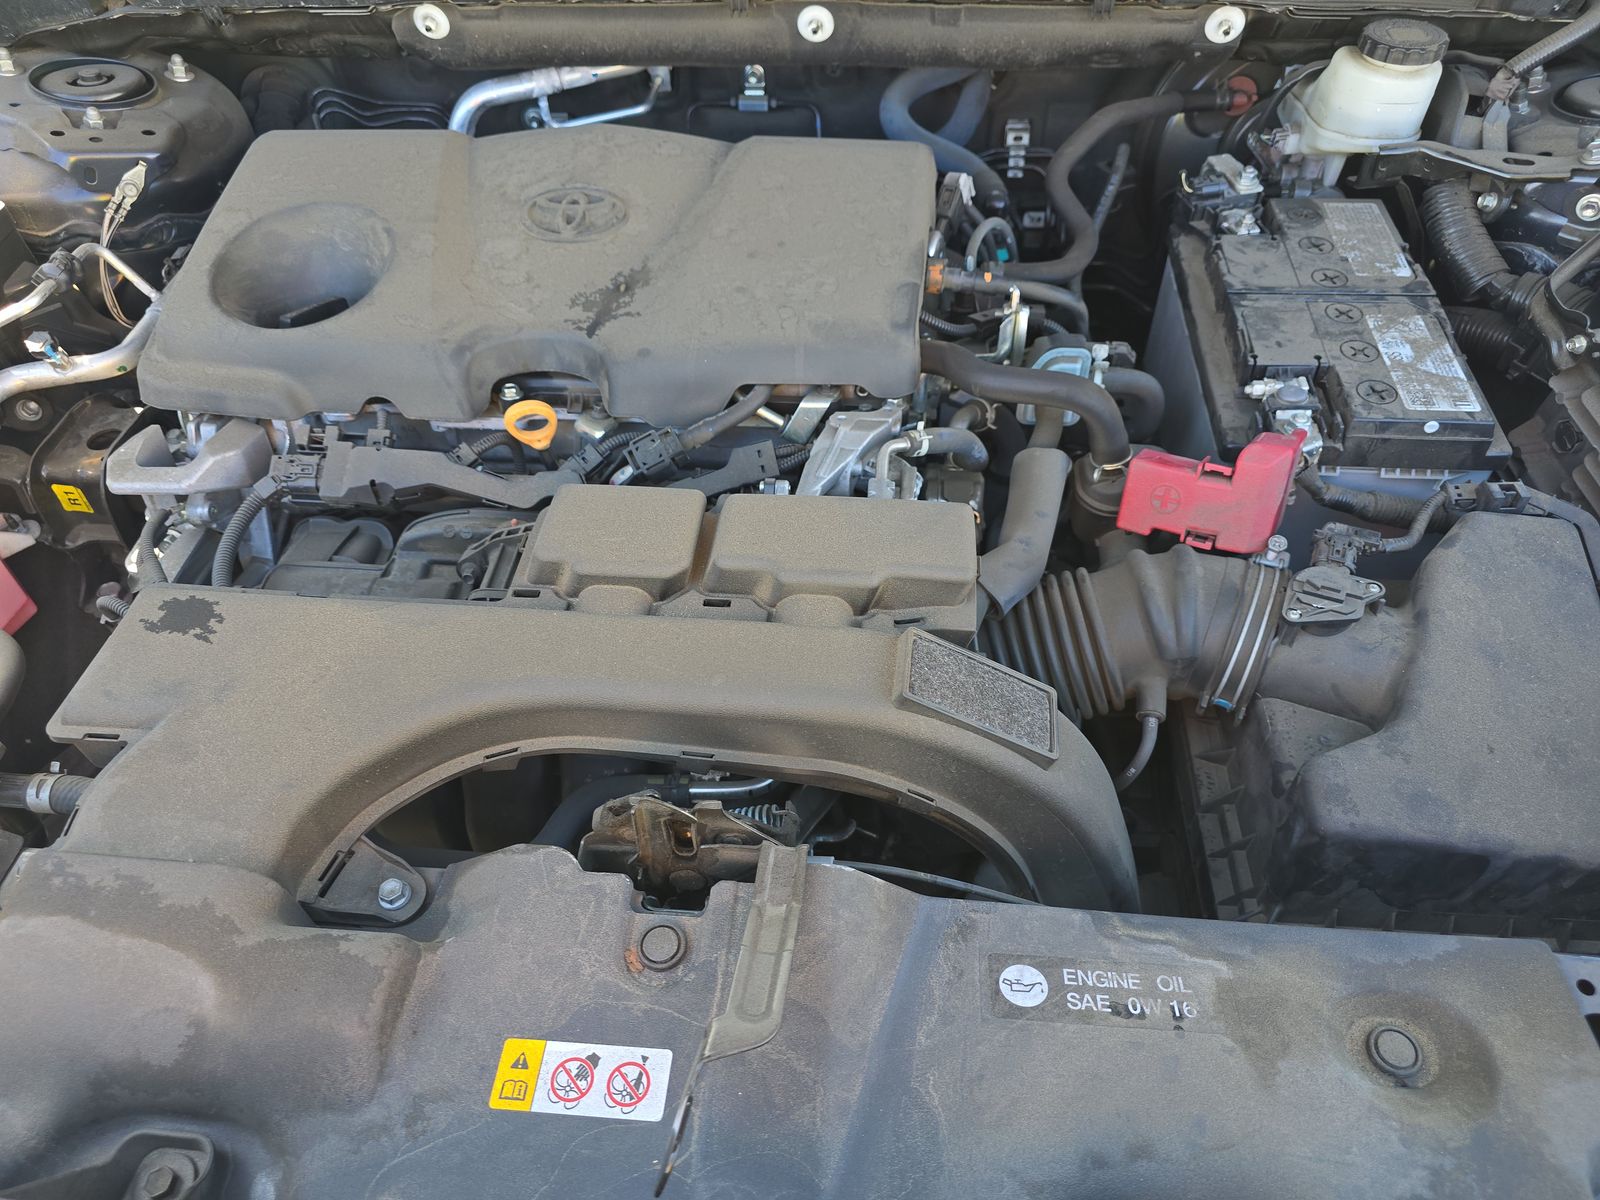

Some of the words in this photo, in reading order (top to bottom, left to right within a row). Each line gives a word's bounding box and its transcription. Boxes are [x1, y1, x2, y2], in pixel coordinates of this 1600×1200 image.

[1062, 968, 1142, 990] ENGINE
[1156, 974, 1193, 994] OIL
[1066, 992, 1112, 1012] SAE
[1169, 999, 1198, 1018] 16
